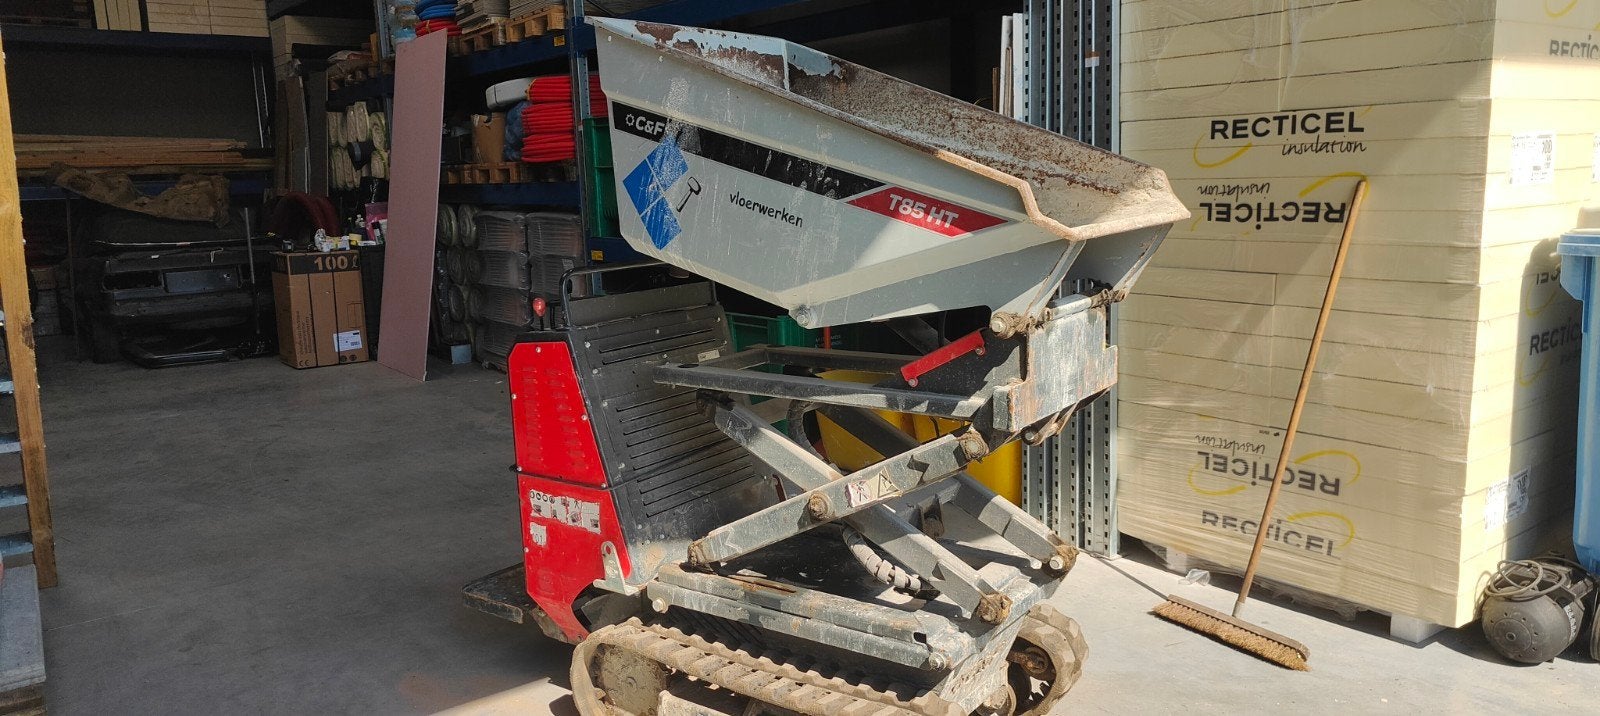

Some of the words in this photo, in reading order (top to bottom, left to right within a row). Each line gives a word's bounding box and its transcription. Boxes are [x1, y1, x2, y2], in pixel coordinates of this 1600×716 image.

[1281, 134, 1367, 156] insulation
[1197, 182, 1271, 202] insulation
[729, 191, 803, 228] vloerwerken
[889, 193, 927, 219] T85
[926, 206, 960, 229] HT
[313, 256, 348, 271] 100
